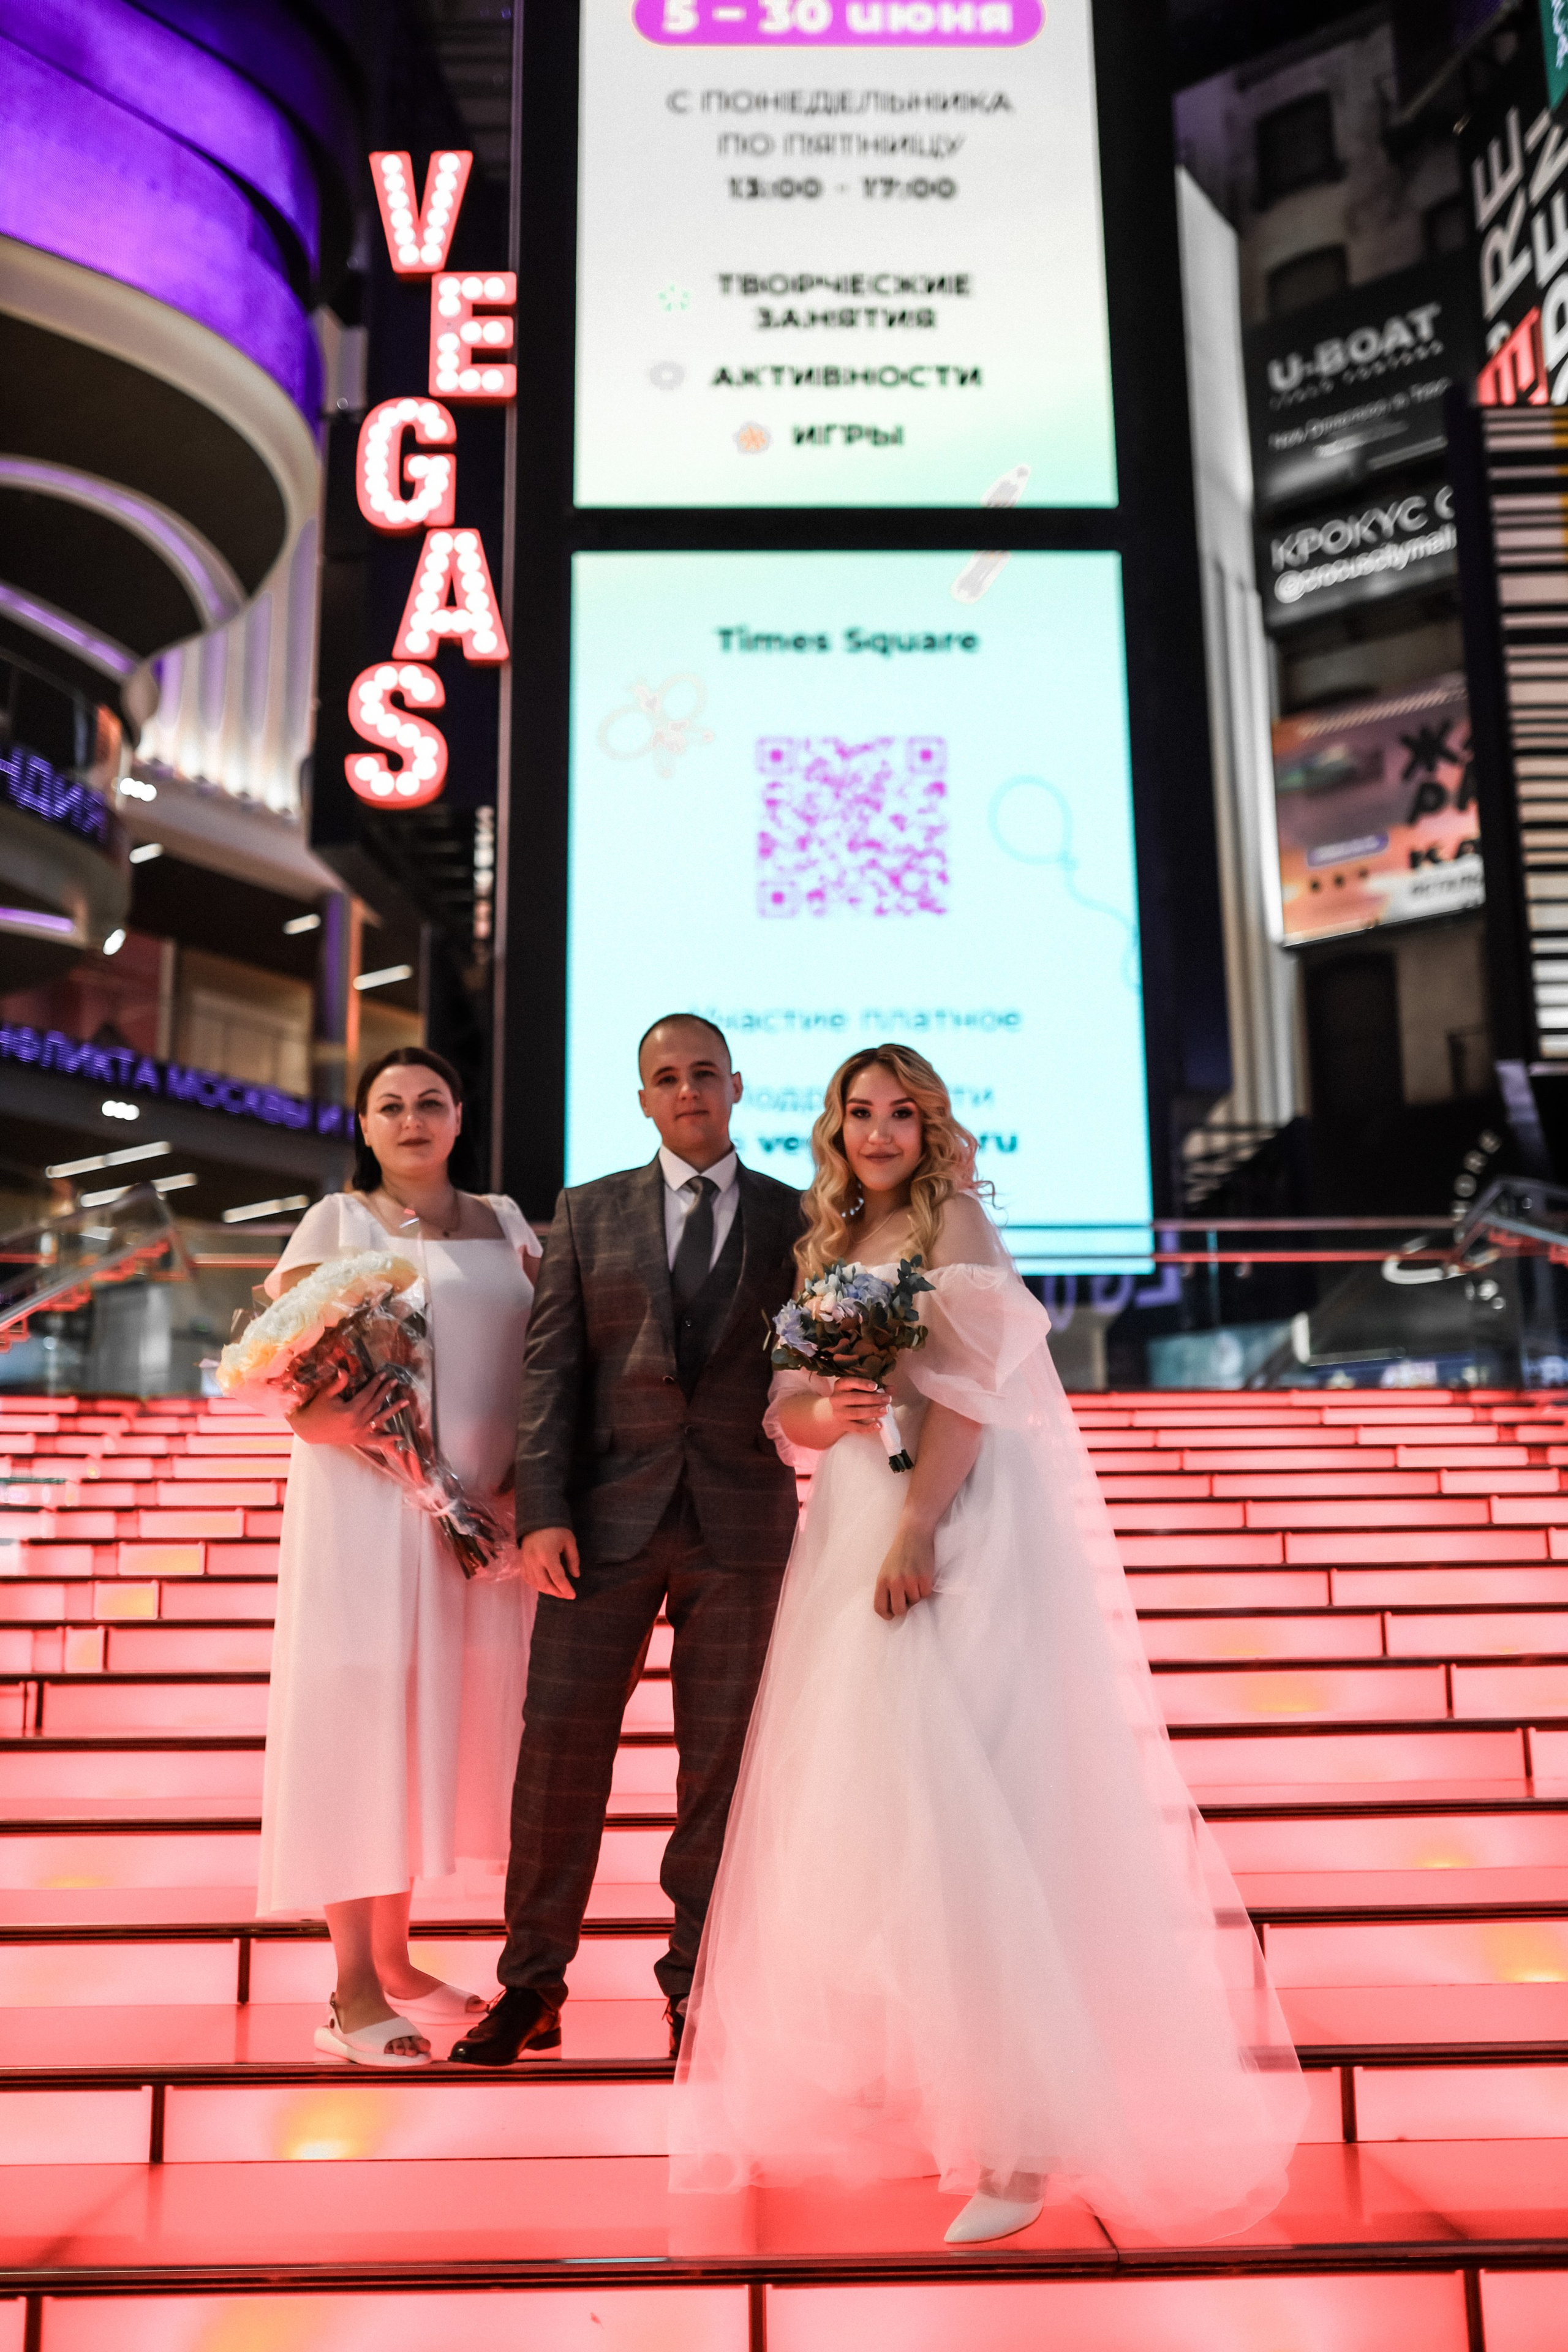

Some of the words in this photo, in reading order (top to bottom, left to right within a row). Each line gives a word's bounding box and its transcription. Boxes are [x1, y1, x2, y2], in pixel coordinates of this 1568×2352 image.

[662, 0, 698, 33] 5
[758, 0, 831, 33] 30
[846, 1, 1013, 33] июня
[701, 89, 1015, 116] ПОНЕДЕЛЬНИКА
[718, 132, 775, 157] ПО
[783, 132, 966, 159] ПЯТНИЦУ
[861, 176, 957, 199] 17:00
[718, 273, 972, 295] ТВОРЧЕСКИЕ
[756, 307, 937, 328] ЗАНЯТИЯ
[1267, 303, 1441, 393] U-BOAT
[710, 366, 982, 388] АКТИВНОСТИ
[792, 424, 904, 447] ИГРЫ
[344, 150, 517, 807] VEGAS
[1270, 495, 1428, 573] КРОКУС
[717, 625, 831, 653] Times
[846, 626, 981, 660] Square
[862, 1006, 1022, 1034] платное
[166, 1063, 312, 1129] МОСКВЫ
